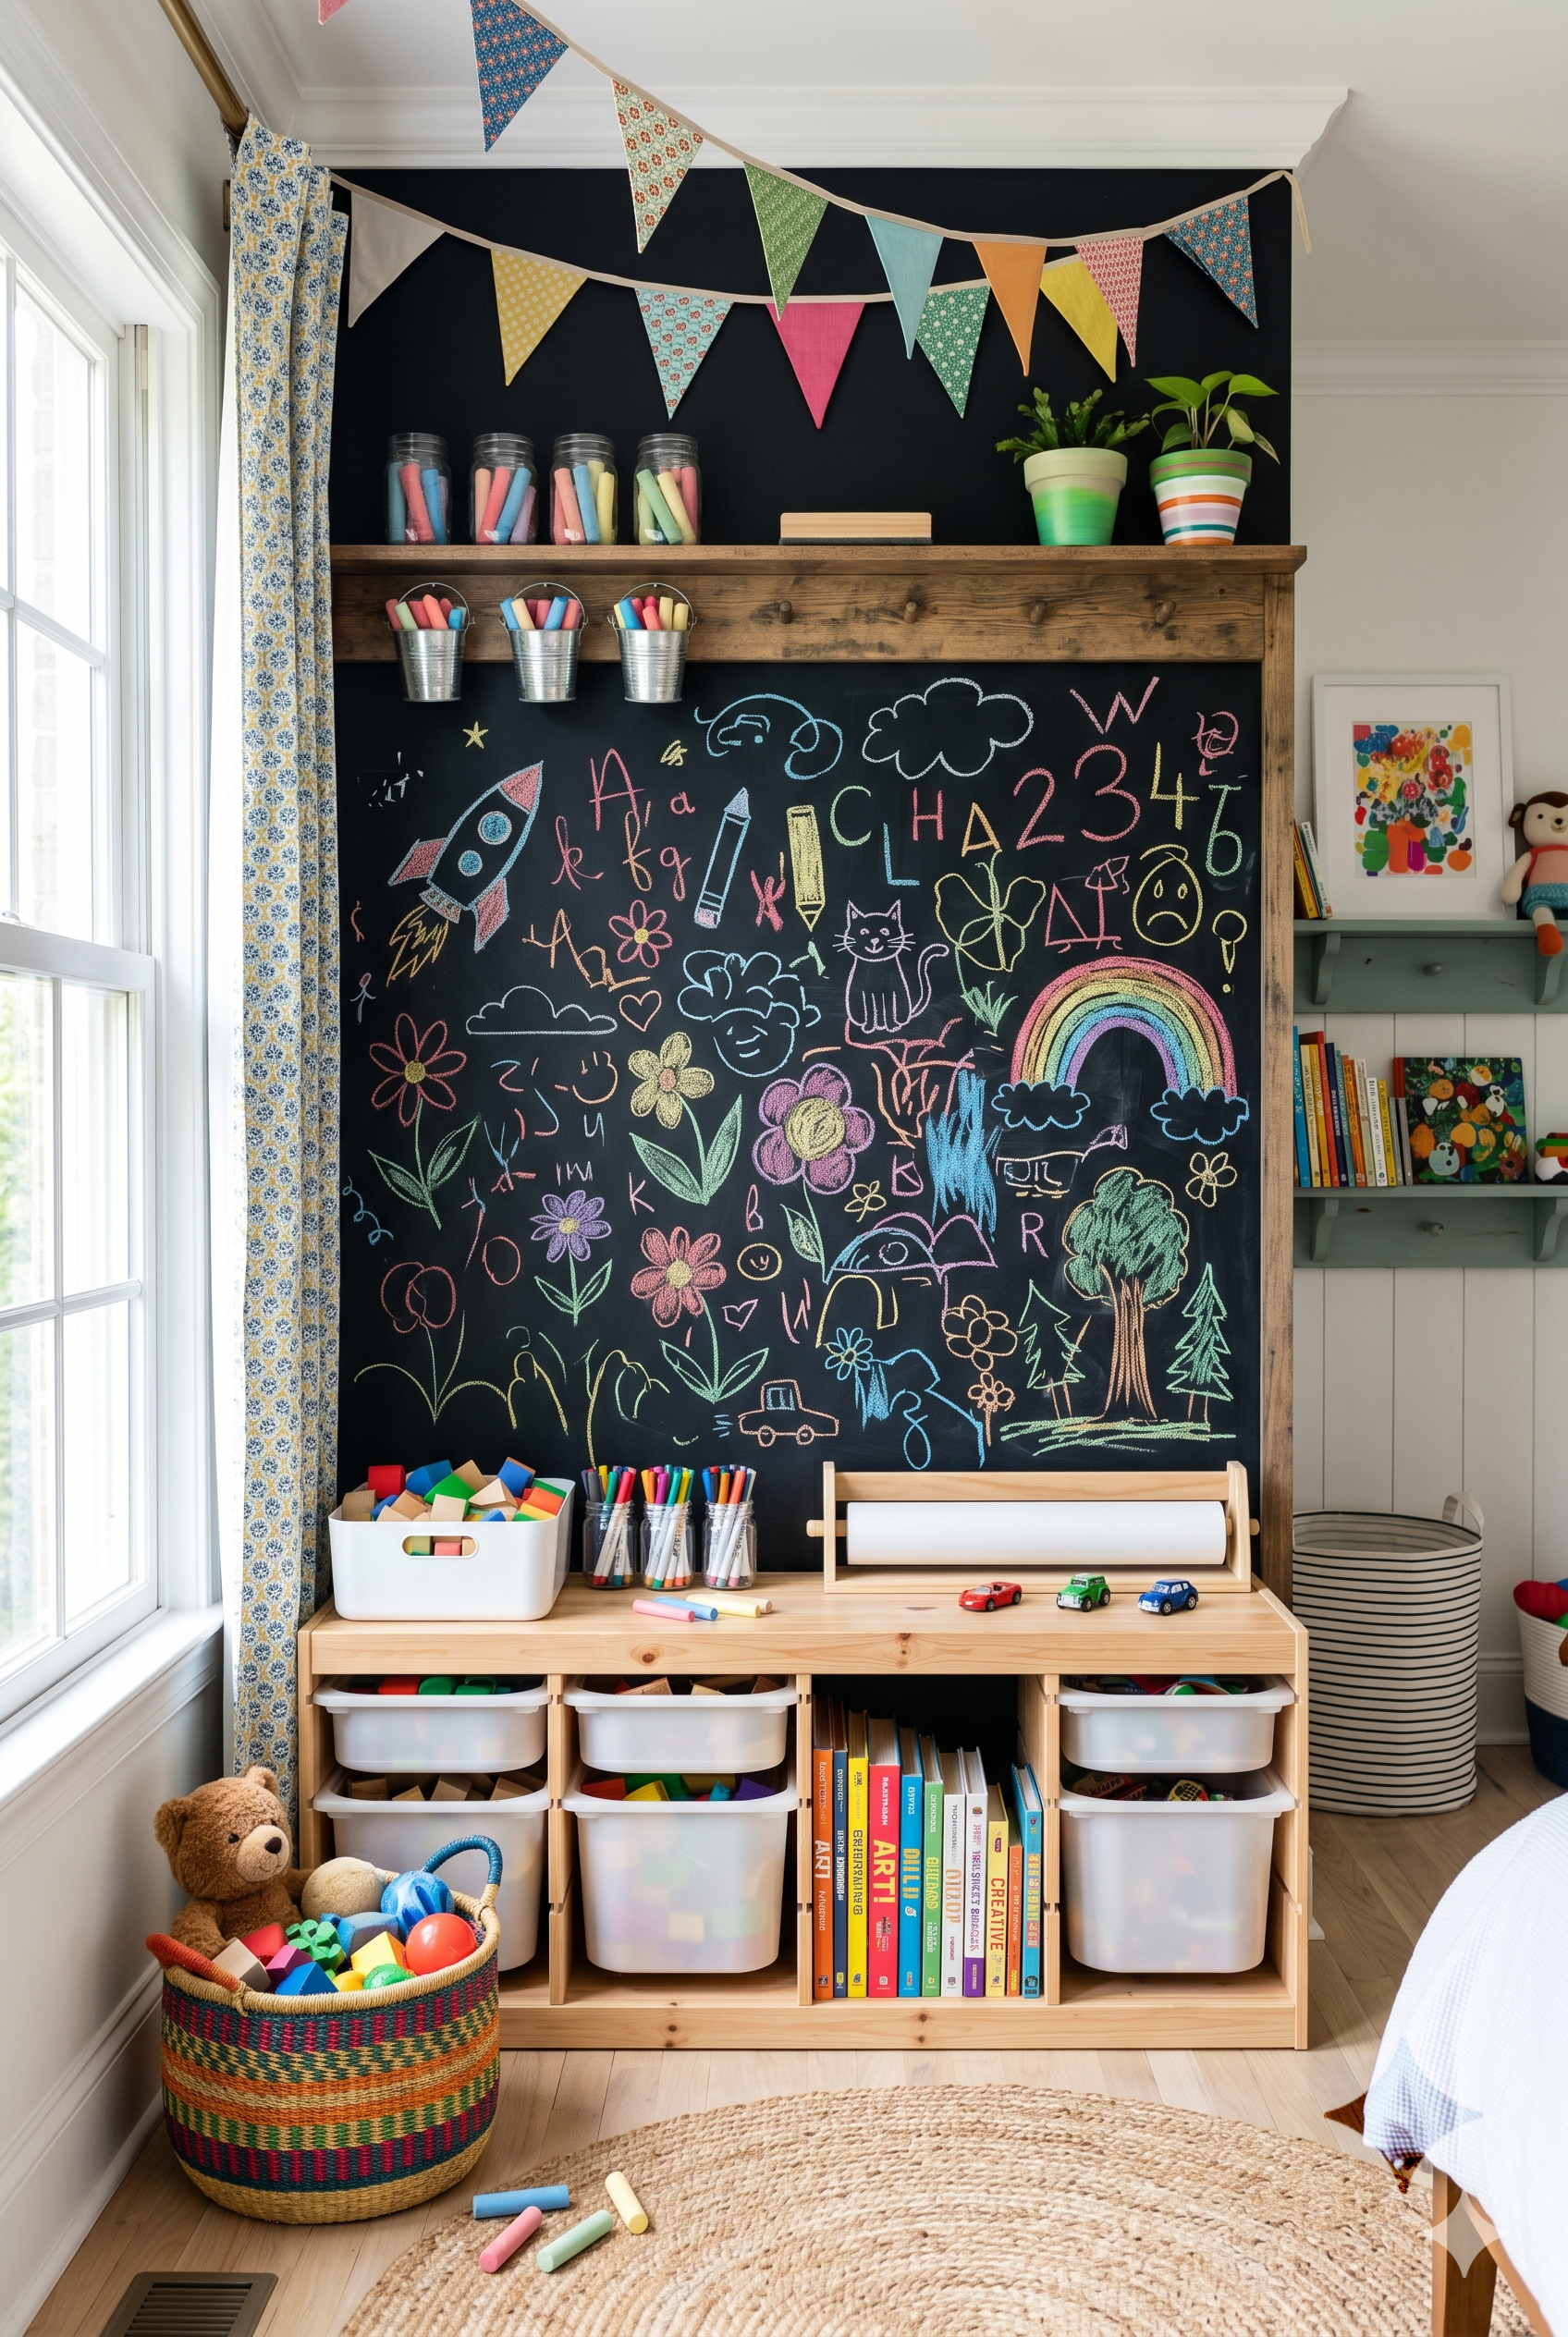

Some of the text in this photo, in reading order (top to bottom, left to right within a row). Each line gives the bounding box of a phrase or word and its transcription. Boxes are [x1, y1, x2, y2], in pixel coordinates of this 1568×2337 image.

[1070, 676, 1159, 735] W
[589, 748, 695, 831] A a
[1013, 768, 1065, 850] 2
[1075, 744, 1140, 842] 3
[1150, 741, 1200, 830] 4
[830, 785, 1002, 886] C L H A
[629, 1171, 655, 1216] K
[1021, 1212, 1049, 1259] R
[873, 1839, 897, 1904] ART!
[990, 1878, 1005, 1952] CREATIVE
